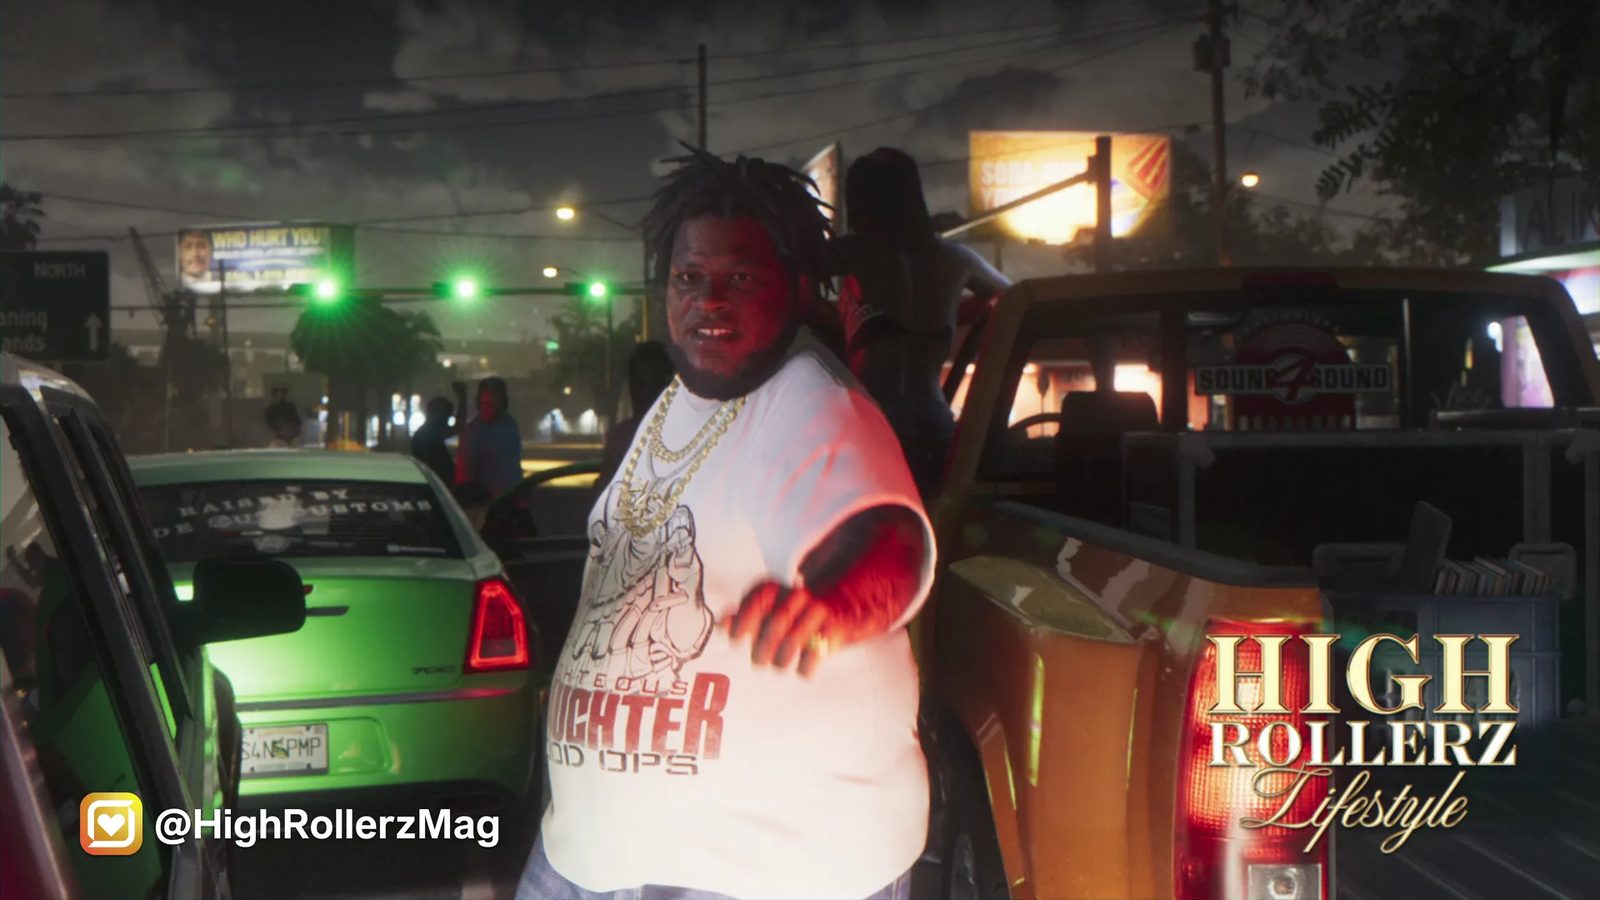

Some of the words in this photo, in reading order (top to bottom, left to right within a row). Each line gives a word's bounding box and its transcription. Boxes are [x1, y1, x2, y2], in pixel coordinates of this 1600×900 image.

[212, 230, 247, 249] WHO
[250, 229, 287, 248] HURT
[33, 261, 87, 279] NORTH
[311, 489, 350, 501] BY
[598, 749, 699, 776] OPS
